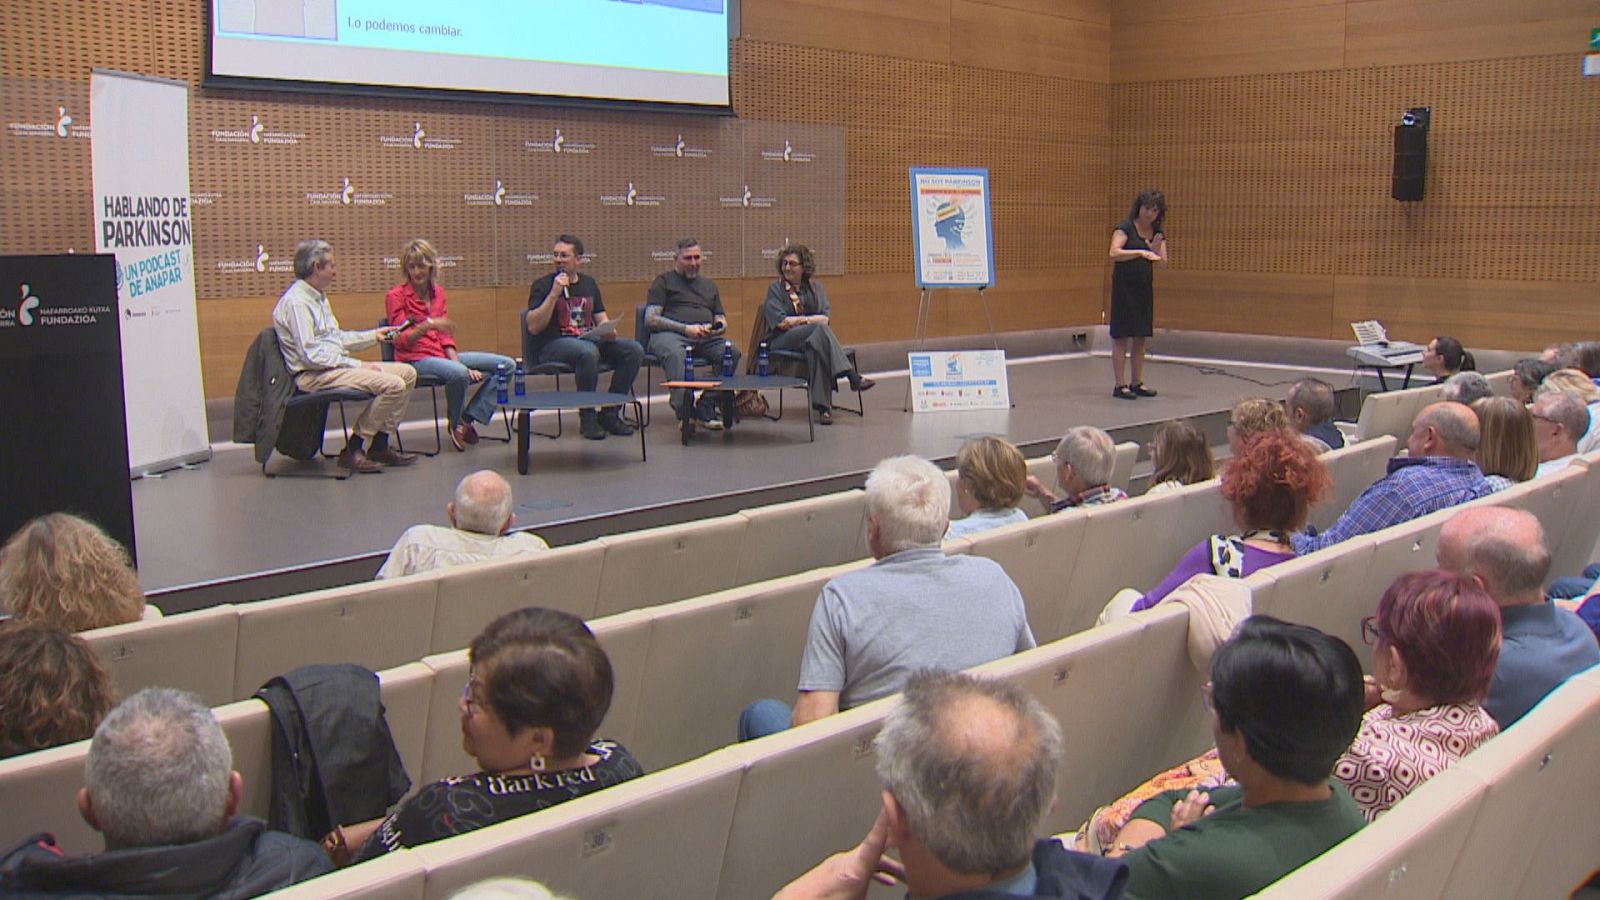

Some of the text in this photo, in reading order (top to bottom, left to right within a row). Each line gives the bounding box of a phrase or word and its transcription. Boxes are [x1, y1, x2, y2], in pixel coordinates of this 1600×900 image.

[348, 16, 463, 37] Lo podemos cambiar.
[212, 129, 249, 137] FUNDACIÓN
[104, 196, 187, 218] HABLANDO DE
[103, 220, 191, 248] PARKINSON
[125, 249, 181, 281] UN PODCAST
[129, 267, 182, 298] DE ANAPAR
[40, 315, 97, 325] FUNDAZIOA
[487, 766, 595, 795] dark red
